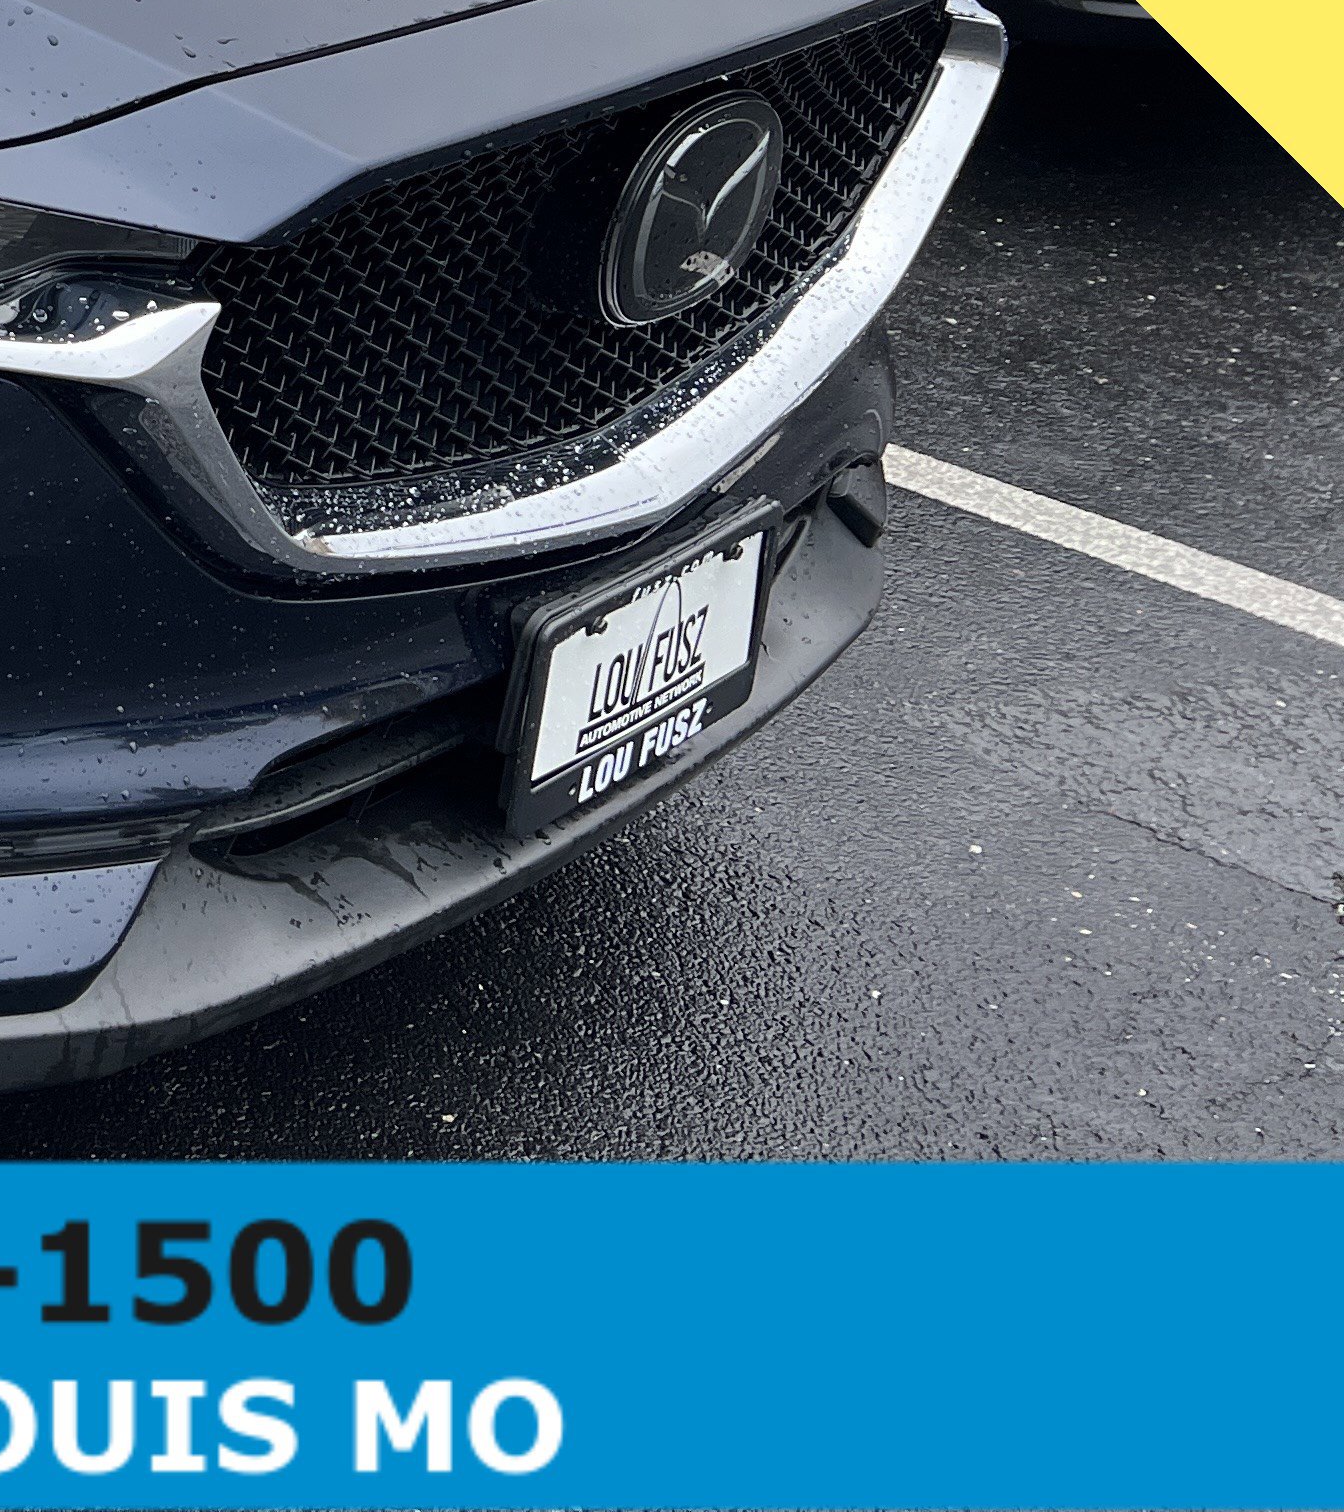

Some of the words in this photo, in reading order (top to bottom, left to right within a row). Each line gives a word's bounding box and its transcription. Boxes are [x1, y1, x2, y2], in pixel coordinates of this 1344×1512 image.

[580, 705, 653, 748] AUTOMOTIVE
[654, 669, 703, 710] NETWORK
[589, 644, 644, 723] LOU
[649, 604, 709, 692] FUSZ
[578, 741, 634, 803] LOU
[638, 697, 708, 768] FUSZ
